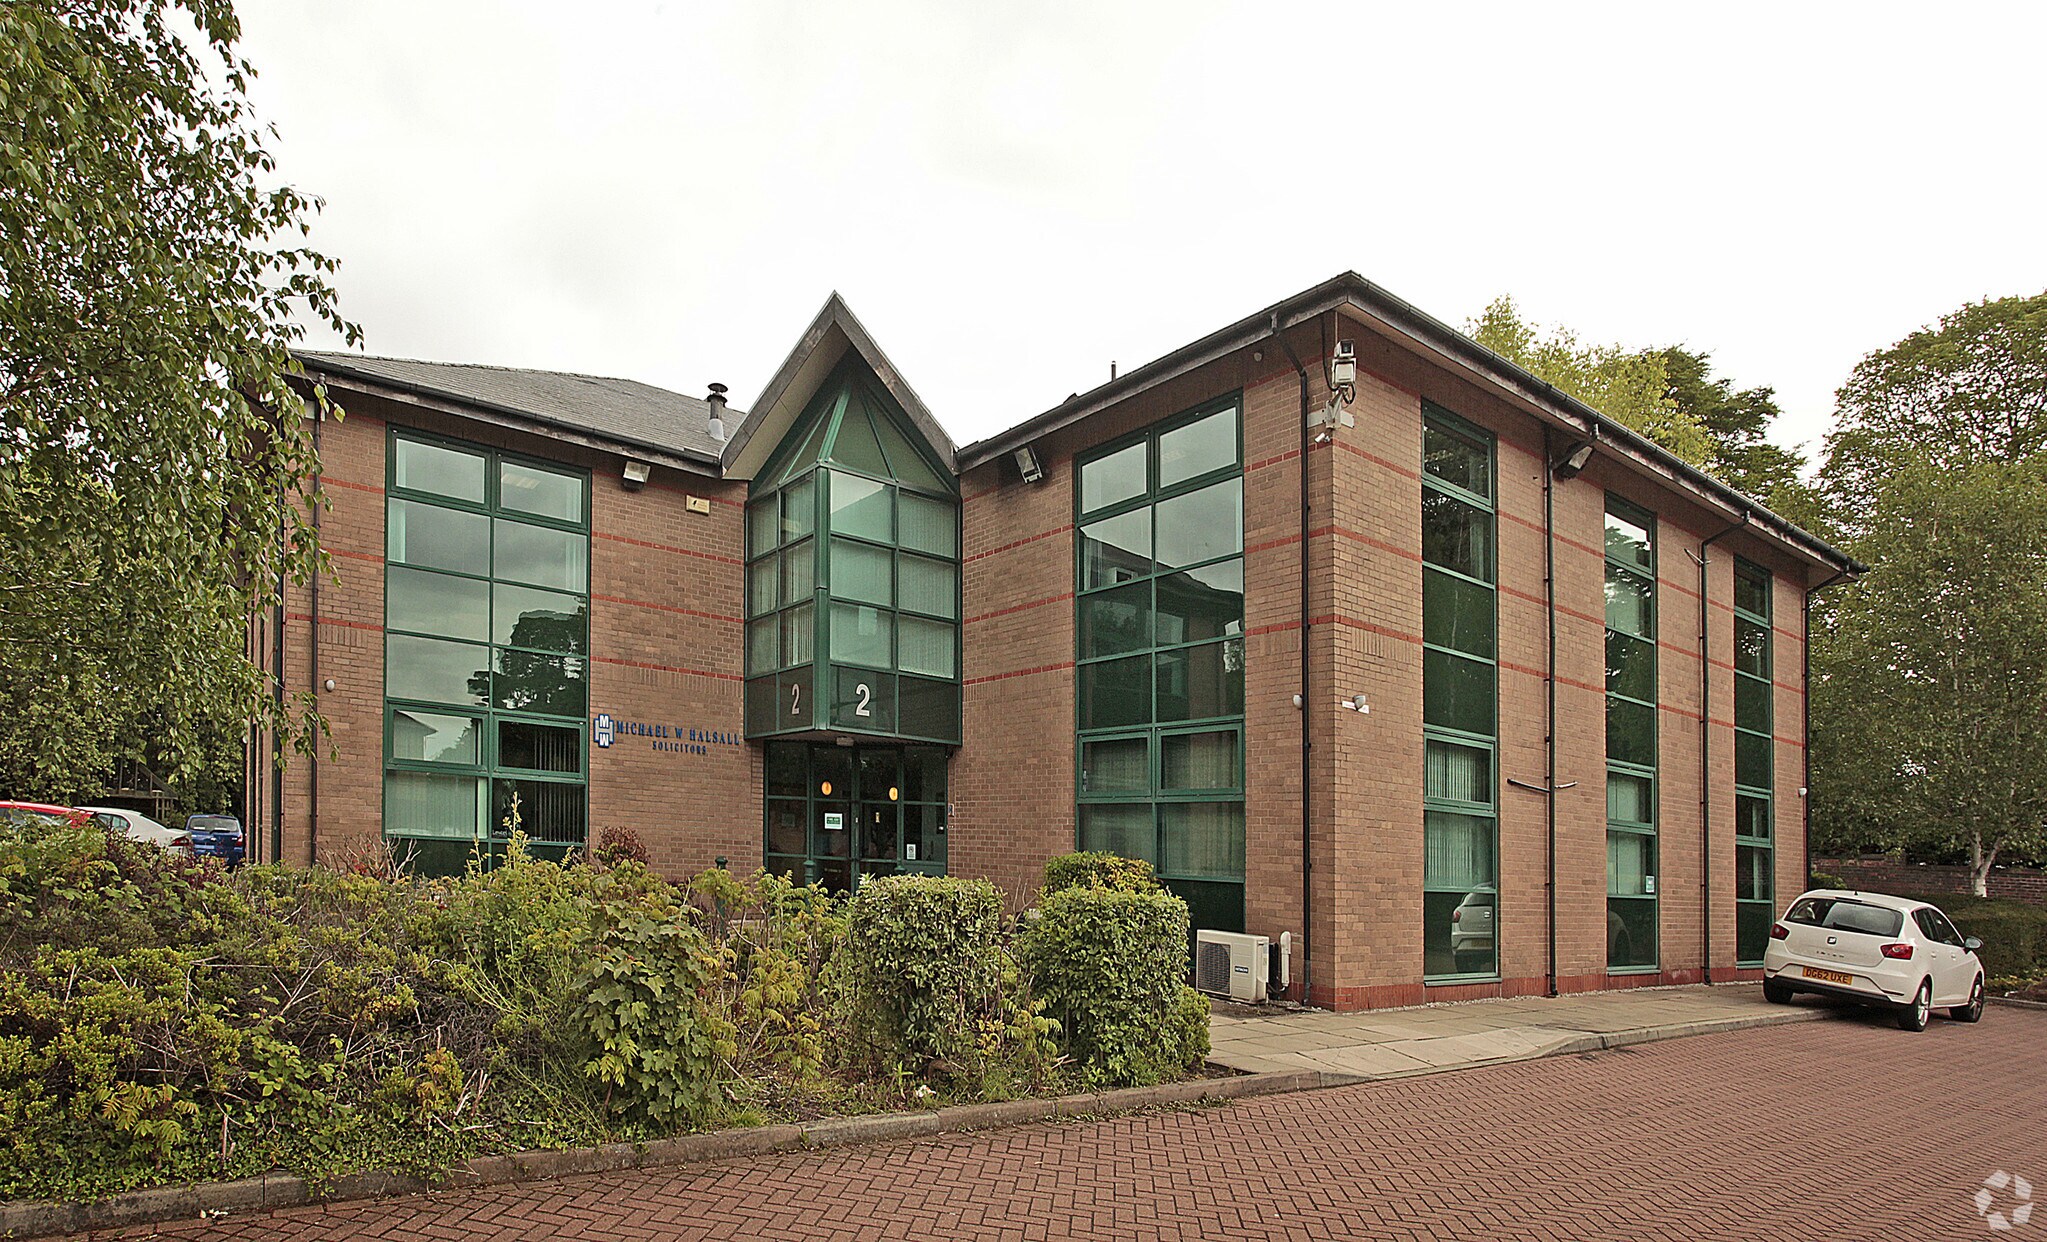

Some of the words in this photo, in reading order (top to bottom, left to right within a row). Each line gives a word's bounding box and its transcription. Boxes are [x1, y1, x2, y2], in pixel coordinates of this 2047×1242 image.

[791, 683, 800, 715] 2
[855, 683, 870, 717] 2
[616, 720, 669, 739] MICHAEL
[674, 727, 683, 739] W
[689, 728, 740, 746] HALSALL
[652, 740, 707, 756] SOLICITORS
[1830, 972, 1848, 984] UXE
